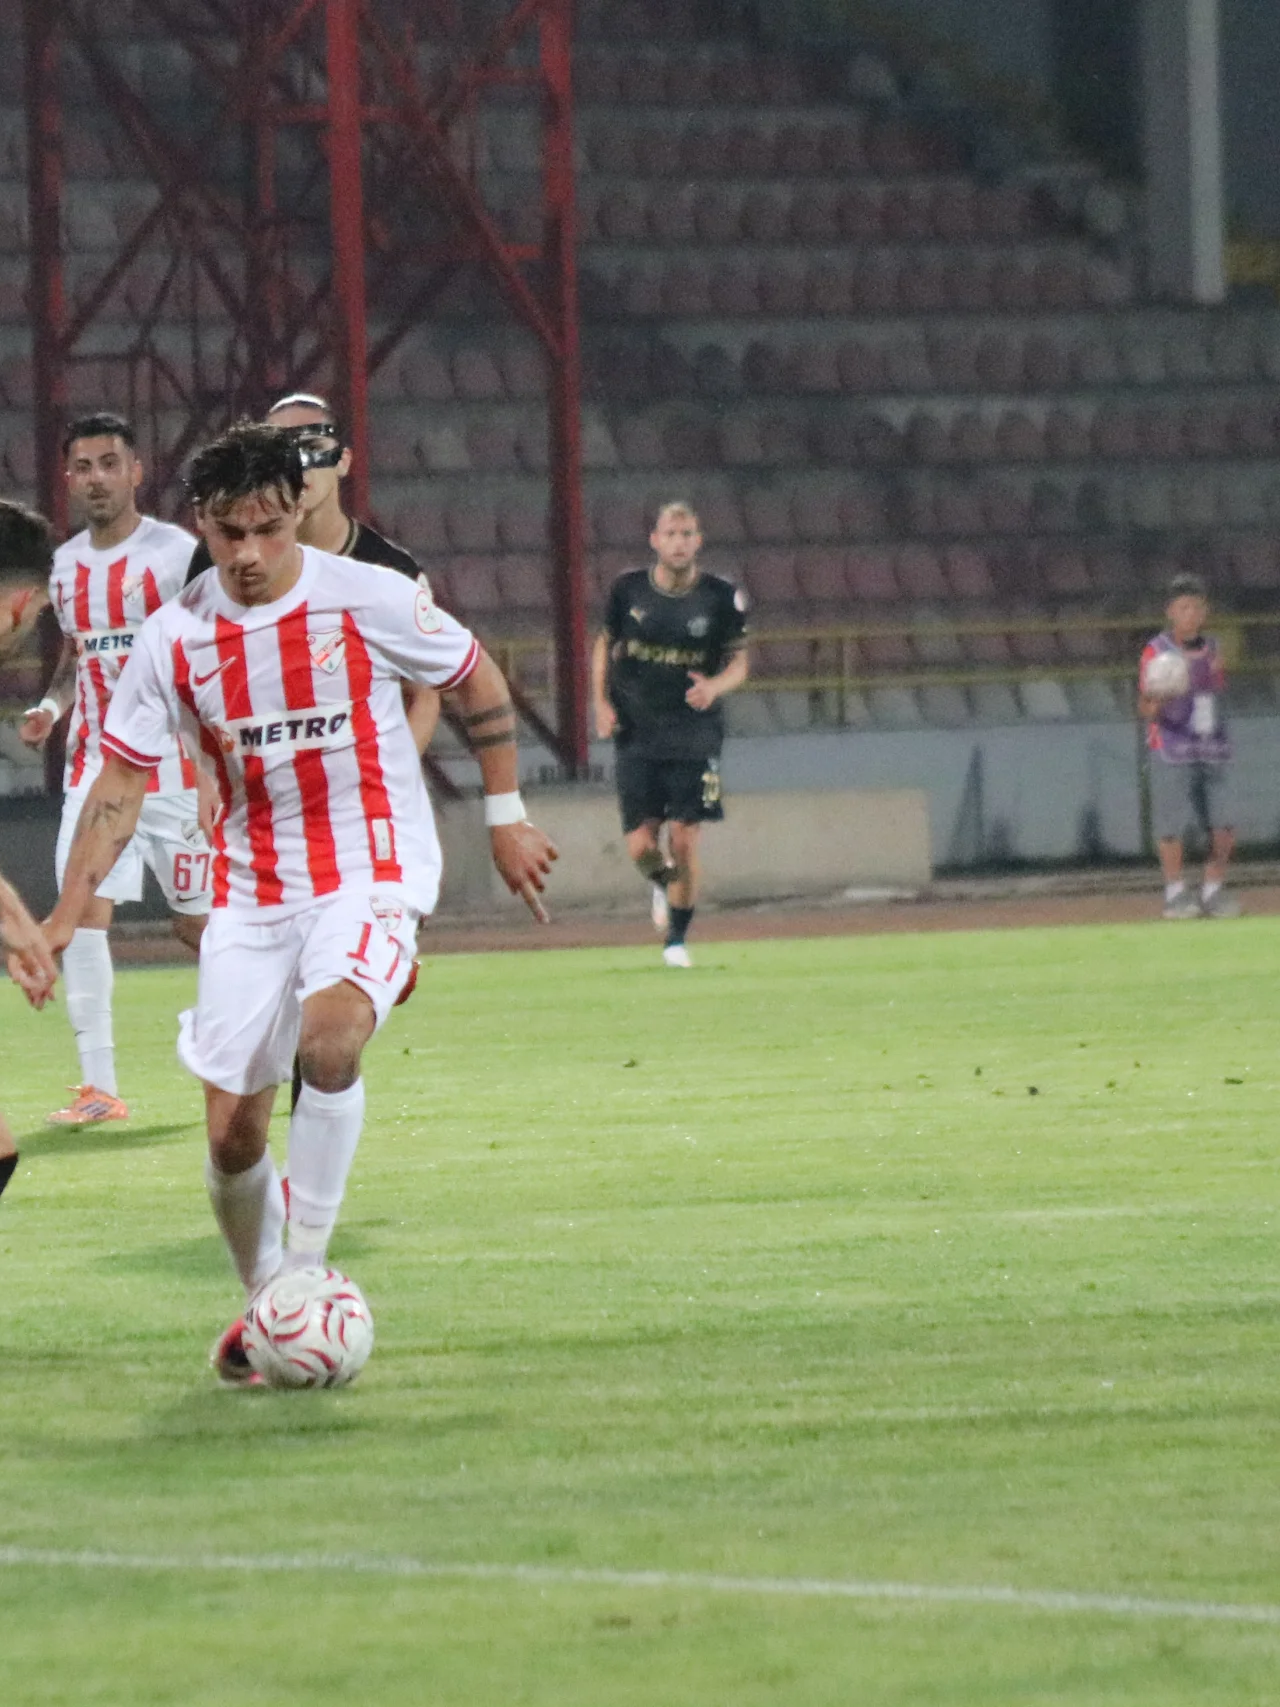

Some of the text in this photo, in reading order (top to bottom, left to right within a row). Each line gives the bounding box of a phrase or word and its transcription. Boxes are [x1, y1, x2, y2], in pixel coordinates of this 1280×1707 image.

[84, 634, 134, 652] METR
[239, 712, 347, 747] METRO
[173, 852, 210, 892] 67
[346, 922, 403, 983] 17
